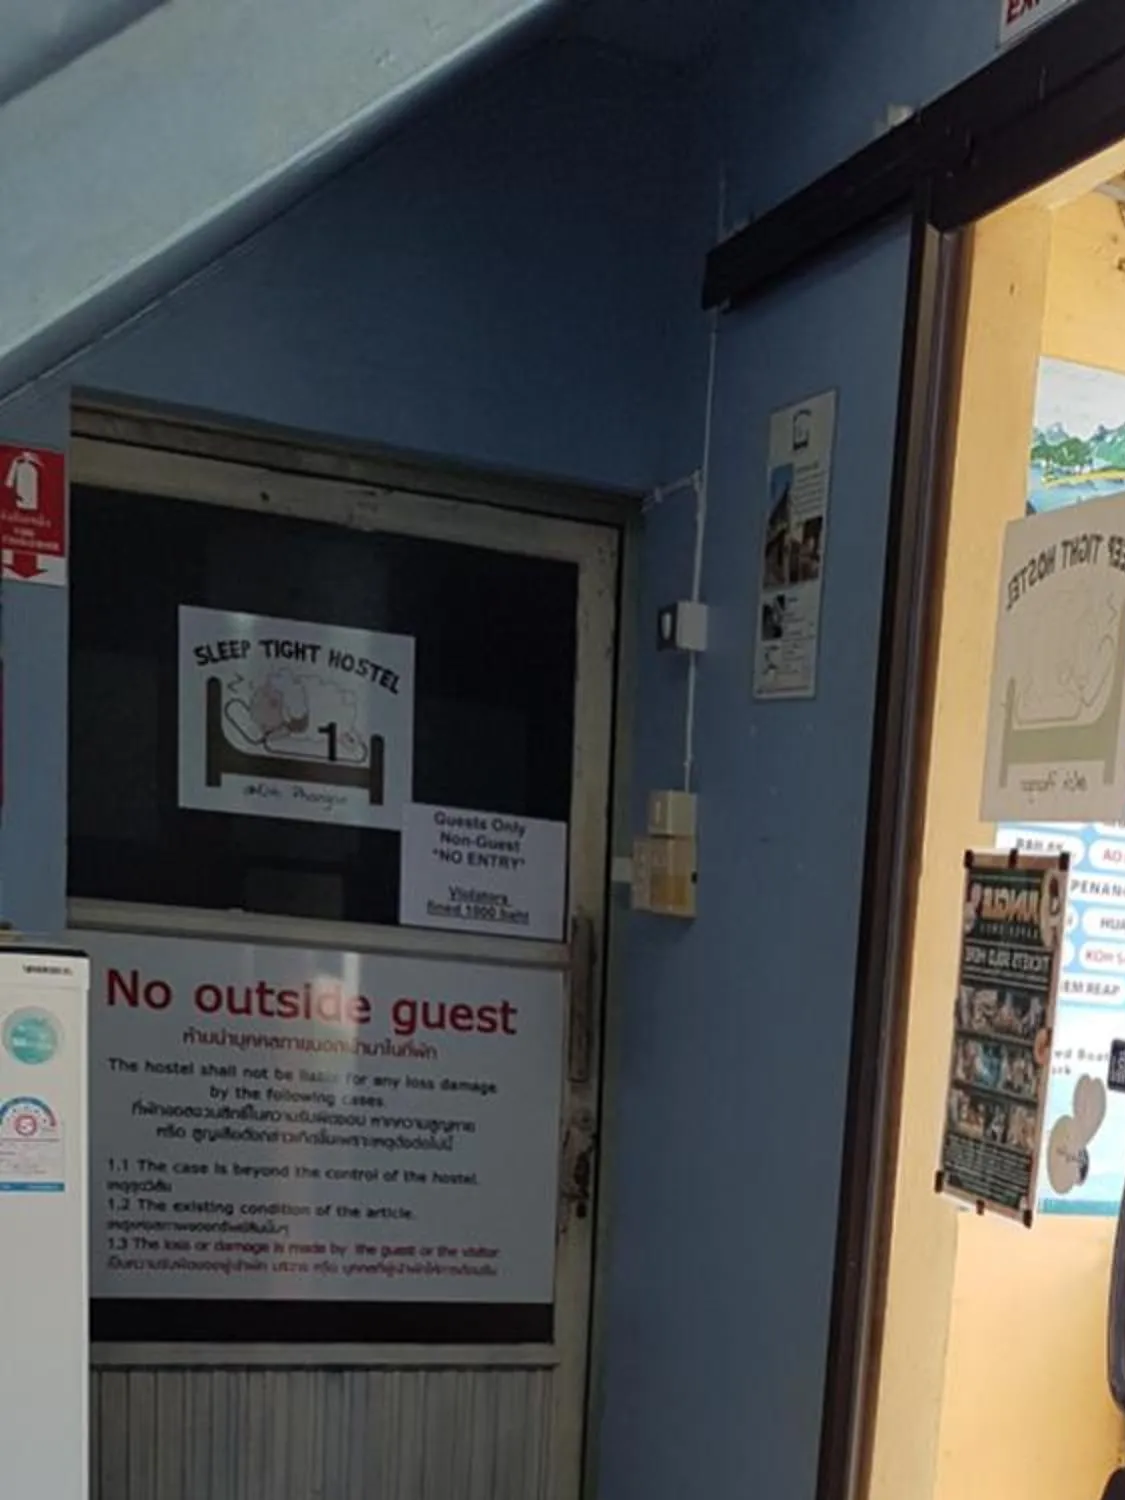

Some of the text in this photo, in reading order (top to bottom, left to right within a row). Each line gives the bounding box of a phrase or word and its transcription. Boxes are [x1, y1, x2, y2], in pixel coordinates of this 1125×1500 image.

[193, 640, 400, 695] SLEEP TIGHT HOSTEL
[318, 722, 337, 761] 1
[434, 810, 526, 837] Guests Only
[440, 831, 521, 853] Non-Guest
[1104, 849, 1123, 862] AO
[1086, 951, 1114, 963] KOH
[1086, 981, 1120, 996] REAP
[107, 968, 518, 1036] No outside guest
[109, 1057, 138, 1073] The
[144, 1060, 194, 1076] hostel
[201, 1062, 237, 1078] shall
[243, 1067, 269, 1080] not
[274, 1067, 294, 1081] be
[345, 1071, 368, 1086] for
[373, 1075, 401, 1089] any
[406, 1074, 435, 1090] loss
[440, 1077, 497, 1097] damage
[209, 1085, 229, 1100] by
[235, 1086, 261, 1100] the
[267, 1087, 335, 1108] following
[109, 1157, 128, 1171] 1.1
[137, 1158, 166, 1172] The
[172, 1162, 208, 1175] case
[214, 1161, 228, 1175] is
[233, 1162, 290, 1179] beyond
[295, 1165, 320, 1180] the
[325, 1167, 379, 1182] control
[383, 1167, 400, 1182] of
[403, 1168, 427, 1184] the
[109, 1197, 130, 1212] 1.2
[137, 1198, 166, 1213] The
[172, 1200, 234, 1216] existing
[240, 1202, 311, 1217] condition
[316, 1204, 332, 1217] of
[337, 1205, 361, 1218] the
[108, 1236, 128, 1250] 1.3
[132, 1237, 160, 1251] The
[164, 1237, 191, 1251] loss
[195, 1240, 210, 1251] or
[214, 1238, 270, 1256] damage
[274, 1241, 284, 1254] is
[289, 1241, 326, 1255] made
[330, 1242, 347, 1258] by
[354, 1242, 376, 1256] the
[381, 1245, 416, 1259] guest
[420, 1247, 433, 1257] or
[437, 1244, 458, 1257] the
